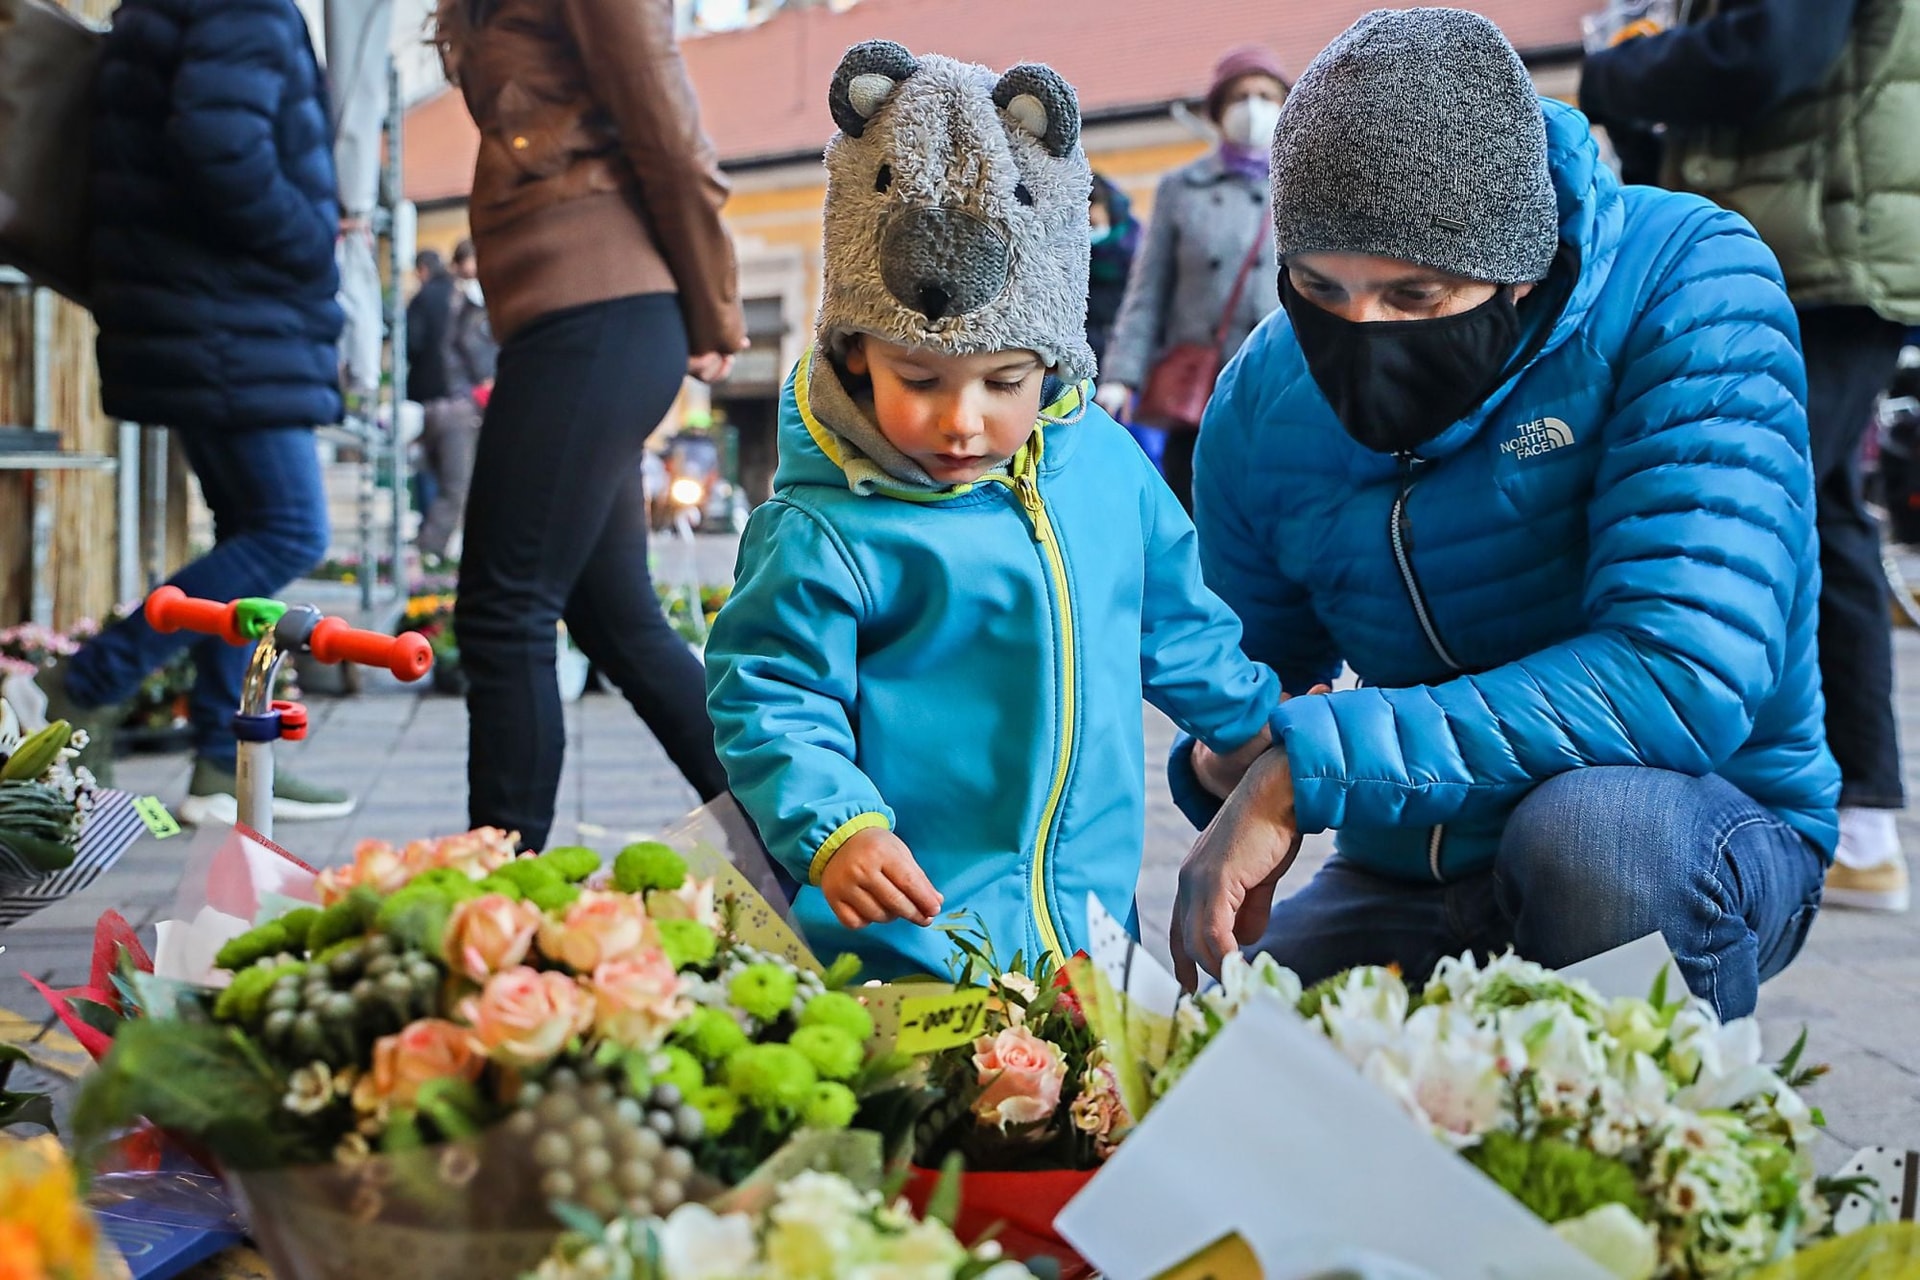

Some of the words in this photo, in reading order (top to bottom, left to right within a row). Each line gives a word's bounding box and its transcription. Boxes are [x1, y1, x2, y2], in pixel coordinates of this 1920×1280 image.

[1516, 419, 1545, 435] THE
[1500, 430, 1547, 454] NORTH
[1516, 441, 1551, 460] FACE
